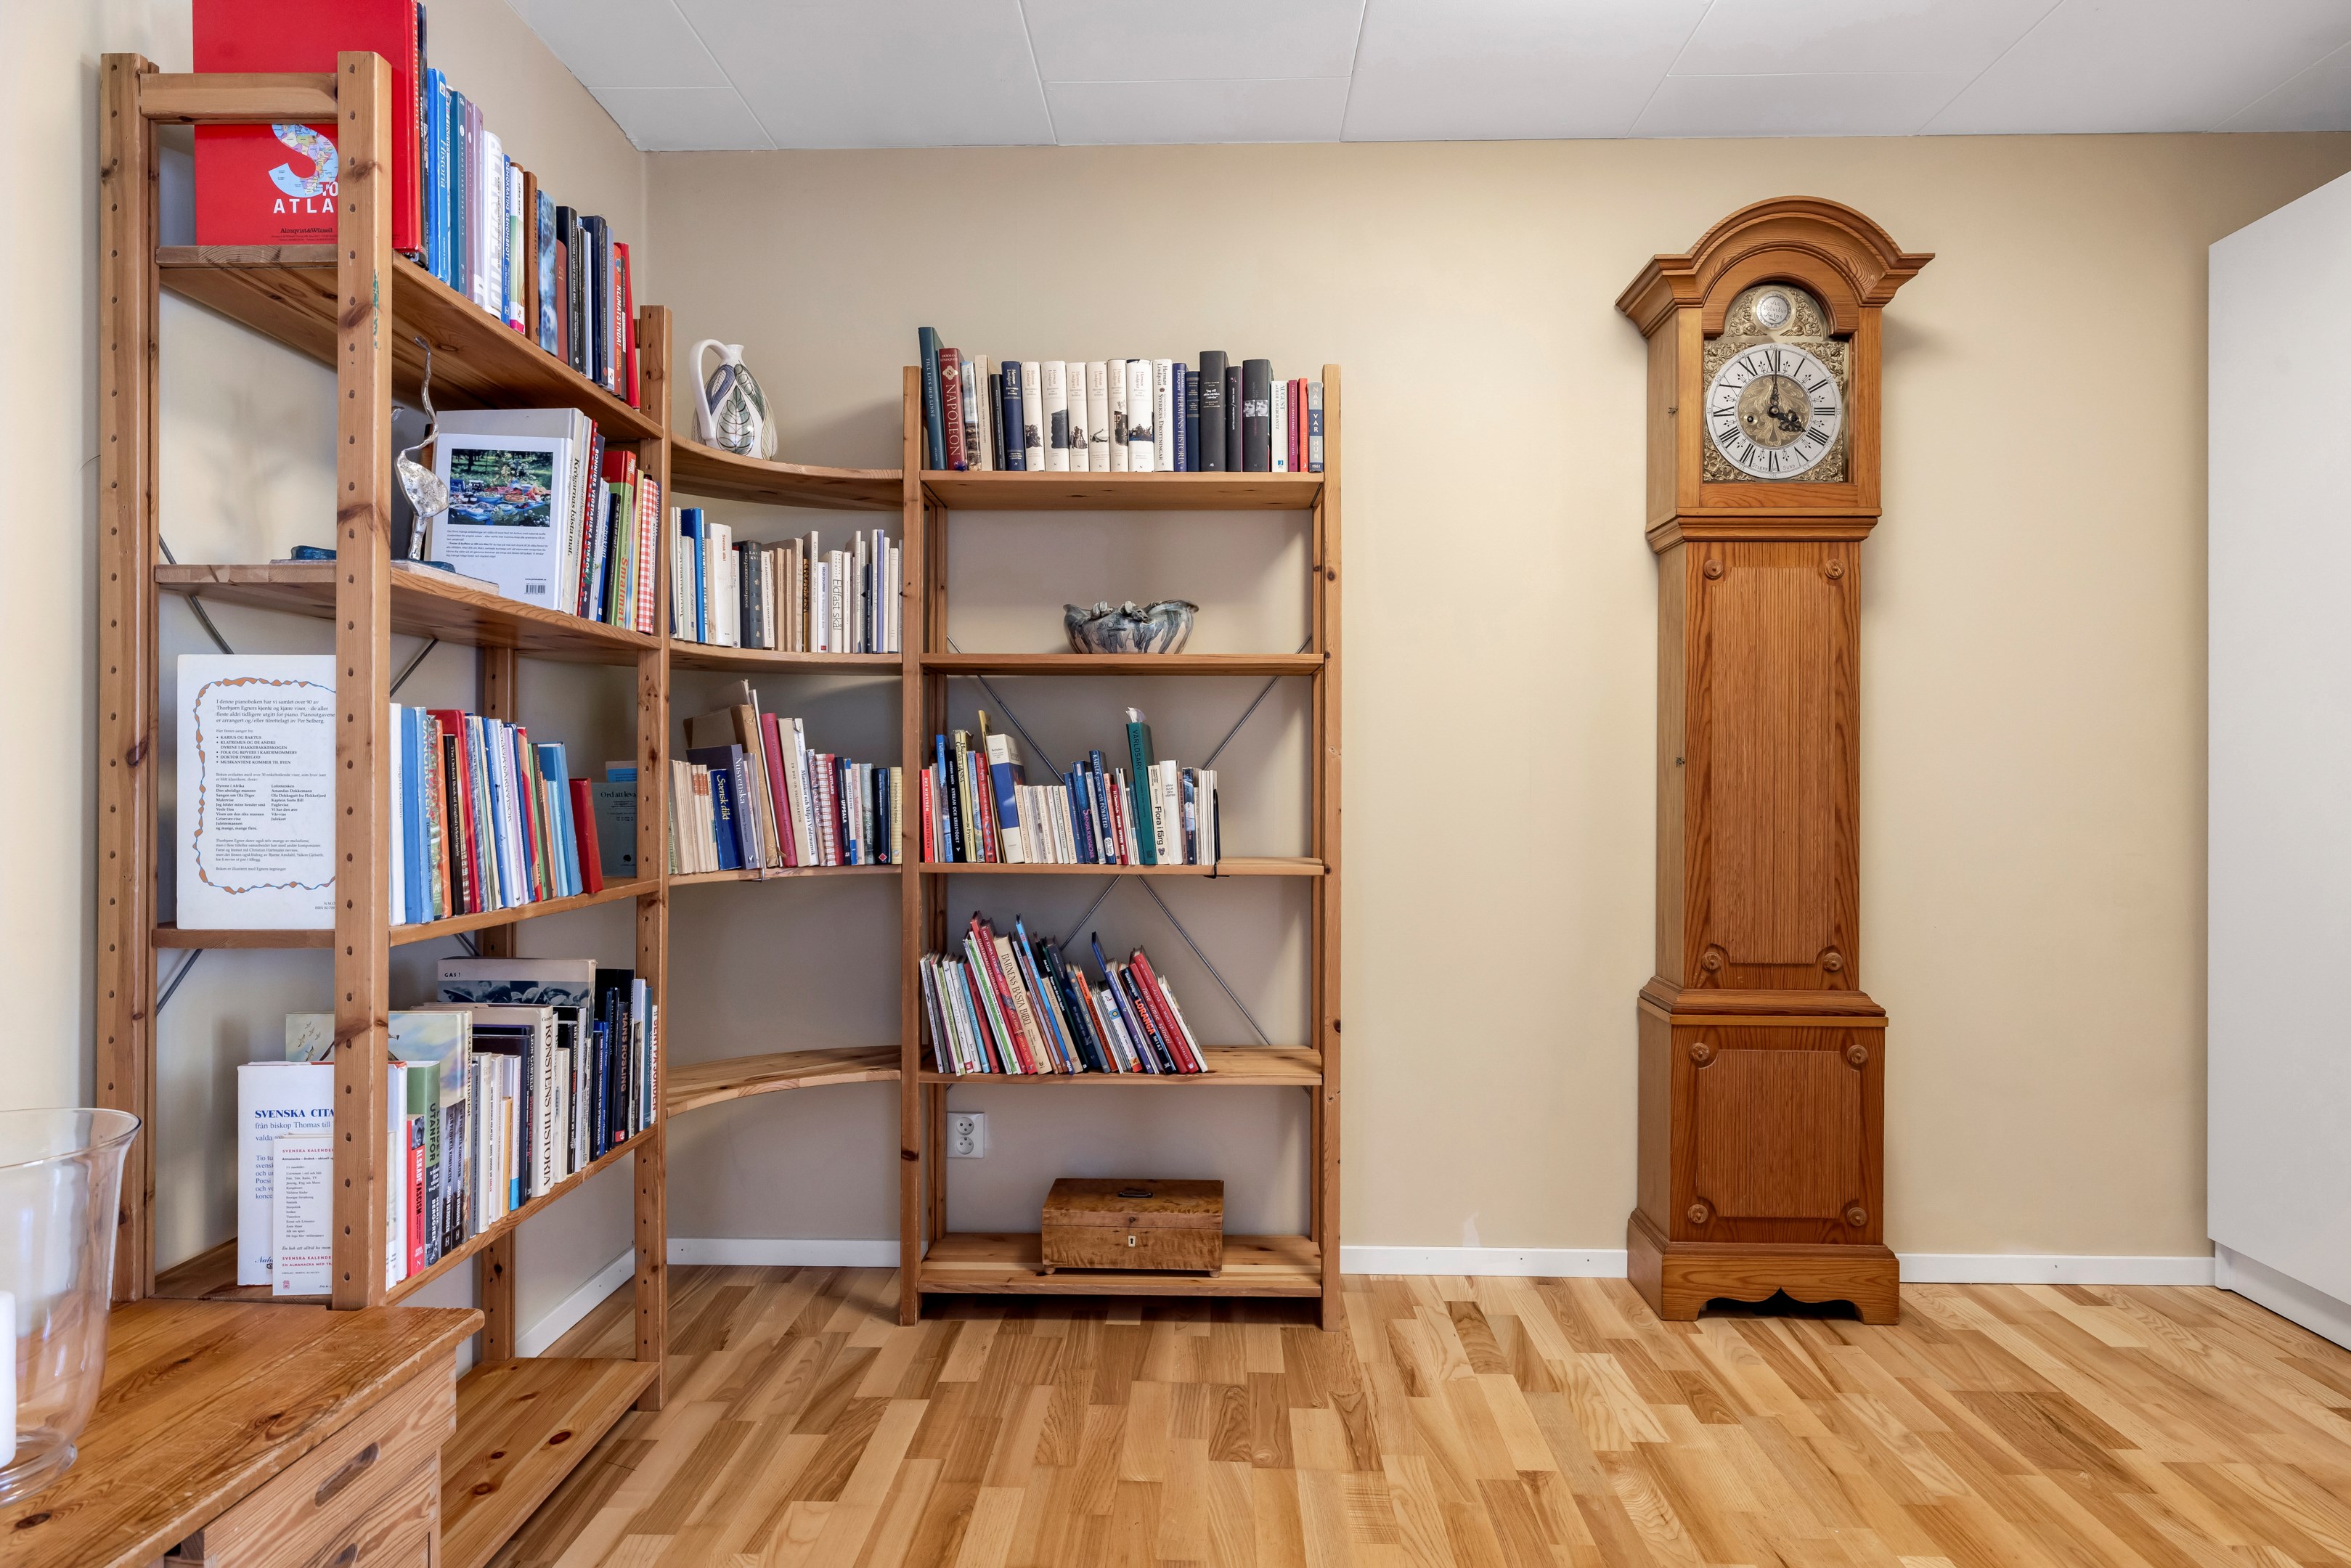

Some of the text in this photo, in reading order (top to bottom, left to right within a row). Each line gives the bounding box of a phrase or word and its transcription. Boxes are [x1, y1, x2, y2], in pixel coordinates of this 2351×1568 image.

[945, 384, 961, 456] NAPOLEON
[571, 457, 580, 510] Krögarnas
[587, 489, 596, 539] VEGETARISKA
[617, 556, 629, 623] Smalmat
[832, 579, 842, 631] Eldfast skål
[1132, 729, 1143, 771] VÄRLDSARV
[717, 775, 730, 821] Svensk dikt
[734, 757, 746, 804] Nusvenska
[806, 822, 816, 857] Valdemarsvik
[1156, 830, 1165, 846] färg
[991, 955, 1001, 973] LEXIKON
[997, 973, 1003, 982] OM
[1001, 952, 1032, 1027] BARNENS BÄSTA BIBEL
[1134, 997, 1157, 1036] LORANGA
[1141, 987, 1172, 1045] Imse vimse spindel
[255, 1109, 306, 1119] SVENSKA
[269, 1122, 292, 1130] biskop
